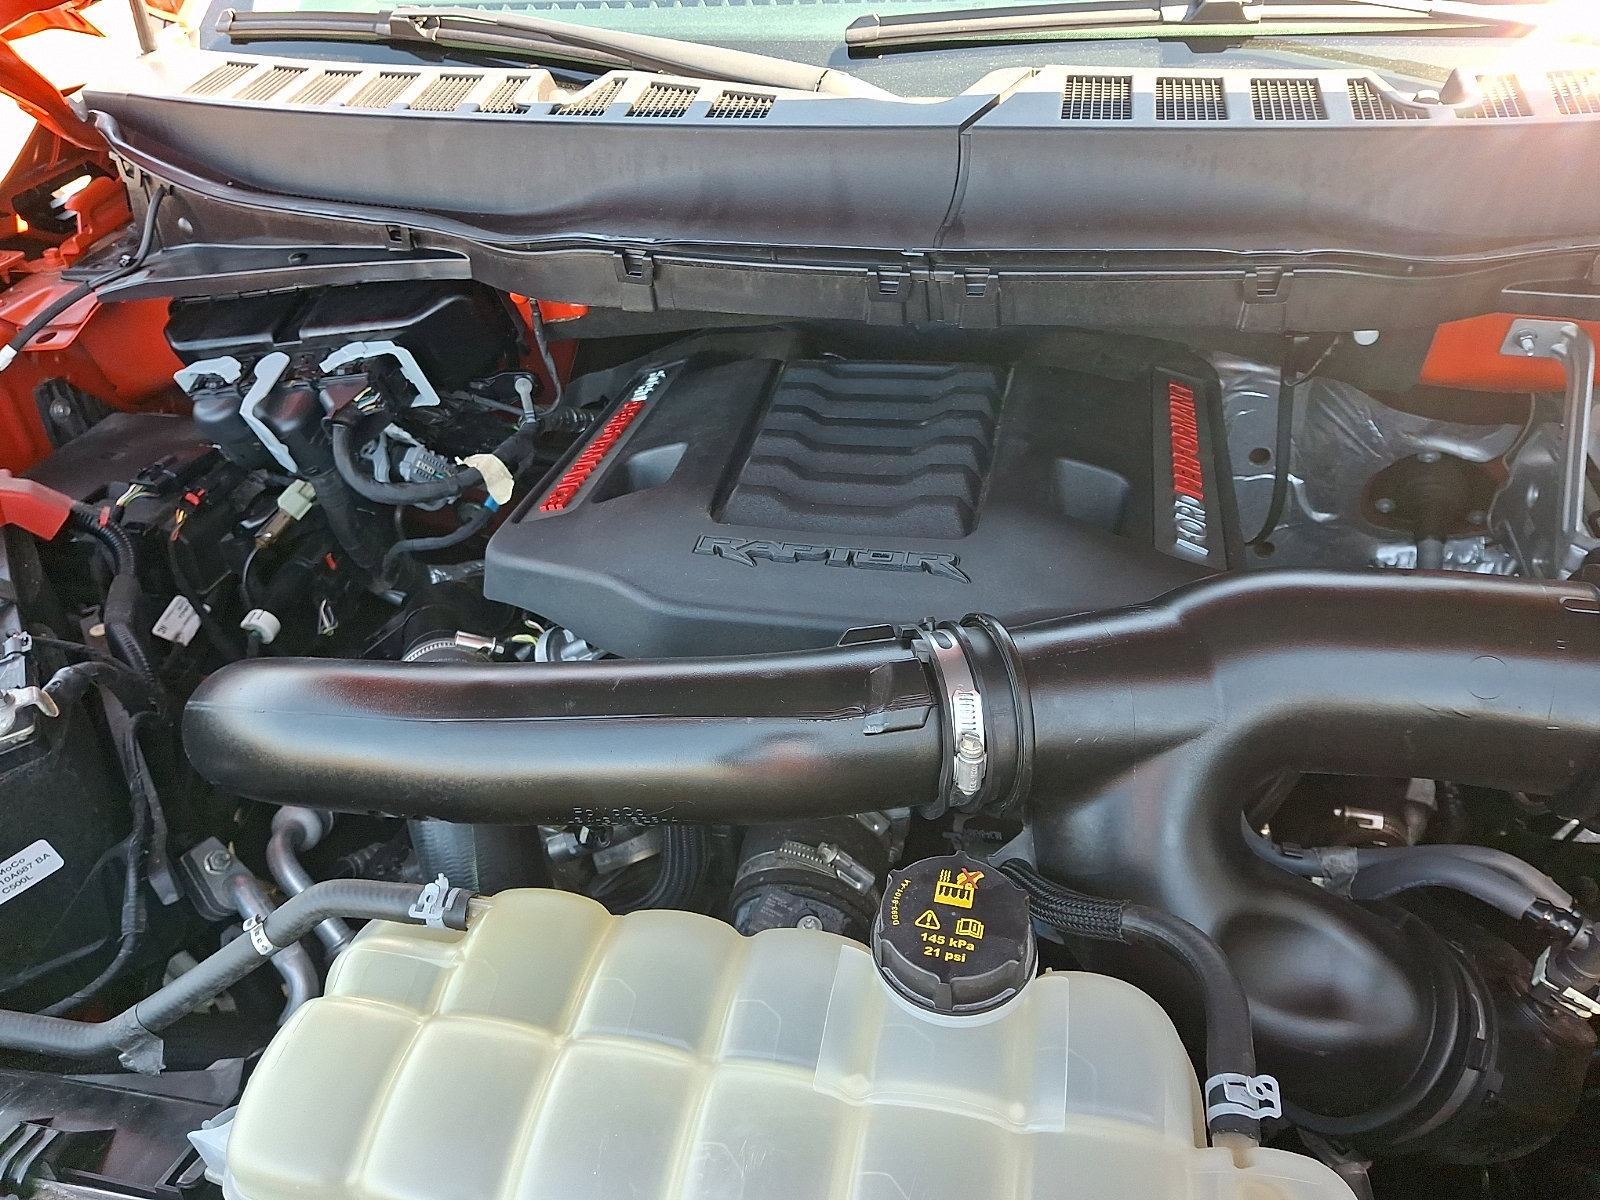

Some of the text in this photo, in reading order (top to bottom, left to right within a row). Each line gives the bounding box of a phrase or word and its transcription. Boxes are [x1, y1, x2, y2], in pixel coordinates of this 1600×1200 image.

[1174, 494, 1209, 556] FORD
[692, 534, 972, 584] RAPTOR
[920, 932, 976, 952] 145 kPa
[924, 946, 967, 963] 21 psi
